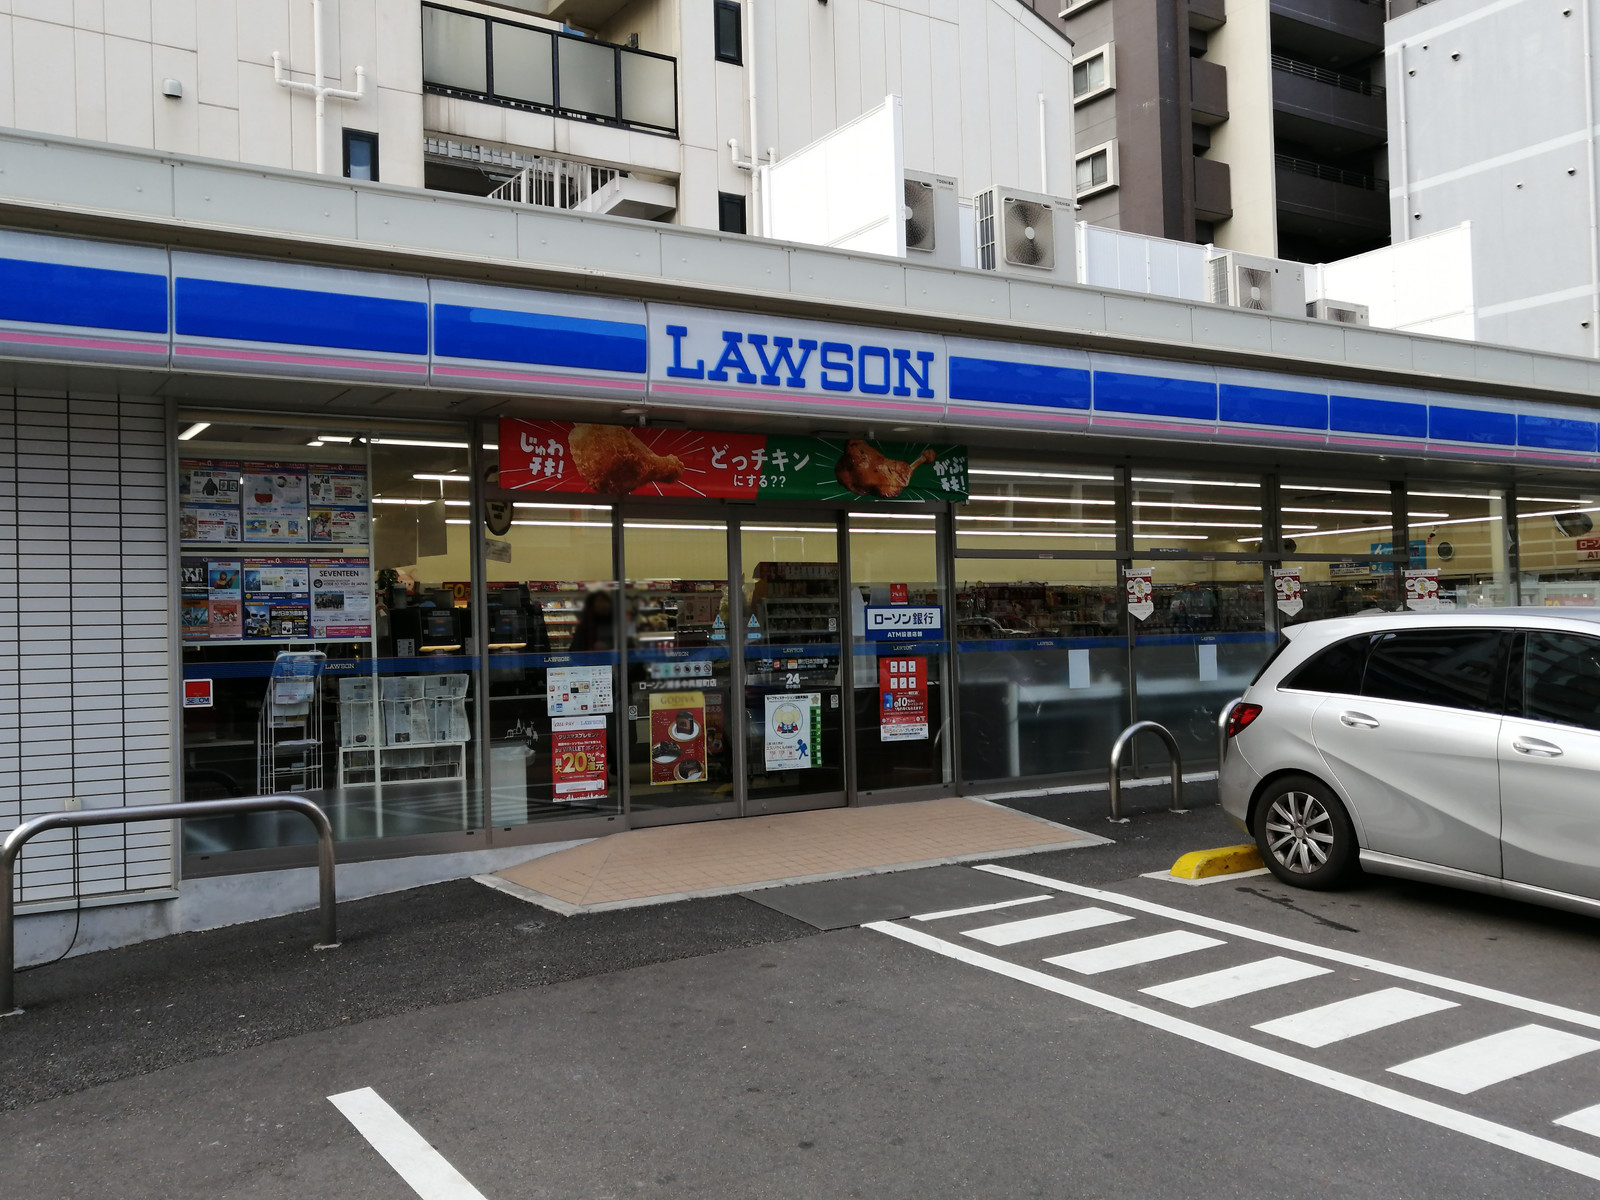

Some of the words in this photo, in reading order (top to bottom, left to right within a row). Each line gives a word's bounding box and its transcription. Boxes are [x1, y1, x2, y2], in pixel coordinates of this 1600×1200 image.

[666, 324, 935, 398] LAWSON
[520, 431, 564, 456] じゅわ
[711, 443, 810, 472] どっチキン
[733, 473, 787, 489] にする??
[874, 612, 934, 625] ローソン銀行
[785, 672, 800, 684] 24
[660, 695, 695, 704] GODIVA
[558, 732, 600, 740] クリスマスプレゼント
